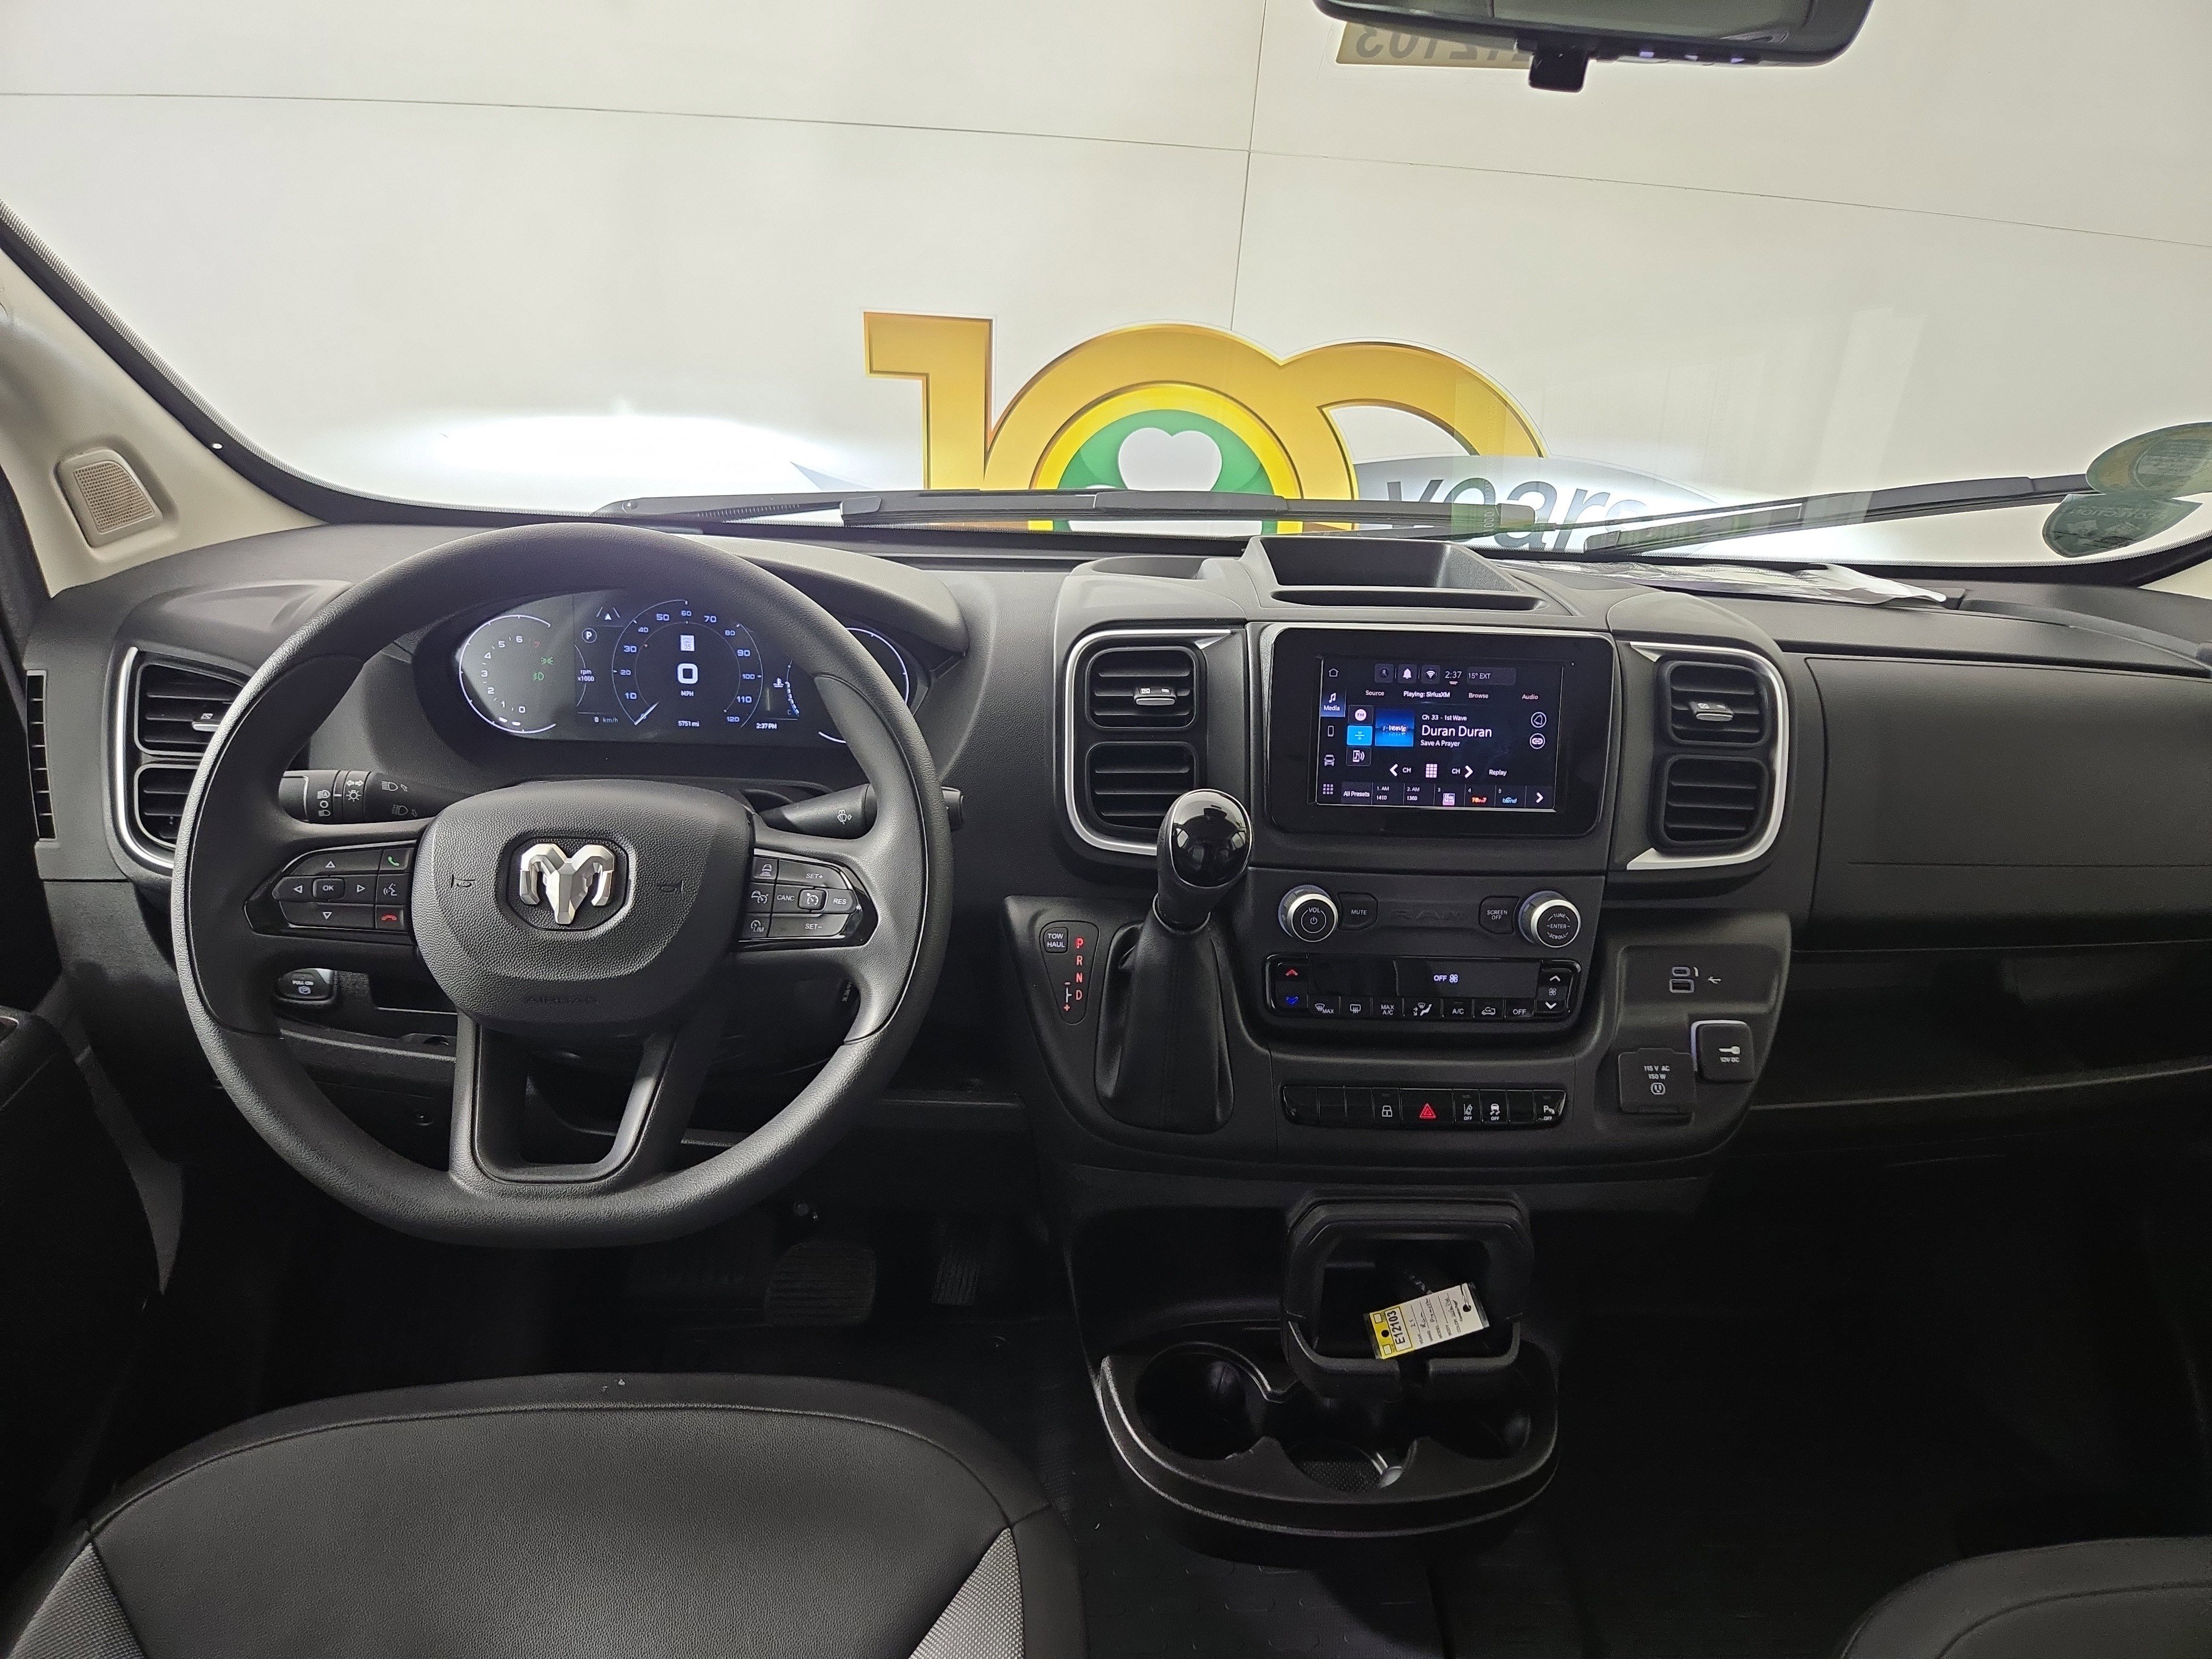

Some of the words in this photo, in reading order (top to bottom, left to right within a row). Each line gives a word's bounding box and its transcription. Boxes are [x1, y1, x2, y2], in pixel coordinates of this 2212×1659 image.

[678, 663, 698, 684] 0
[1422, 725, 1456, 736] Duran
[1458, 726, 1492, 737] Duran
[1076, 938, 1084, 949] P
[1076, 955, 1083, 966] R
[1076, 973, 1083, 983] N
[1076, 990, 1083, 1000] D
[1388, 1310, 1406, 1345] E12103
